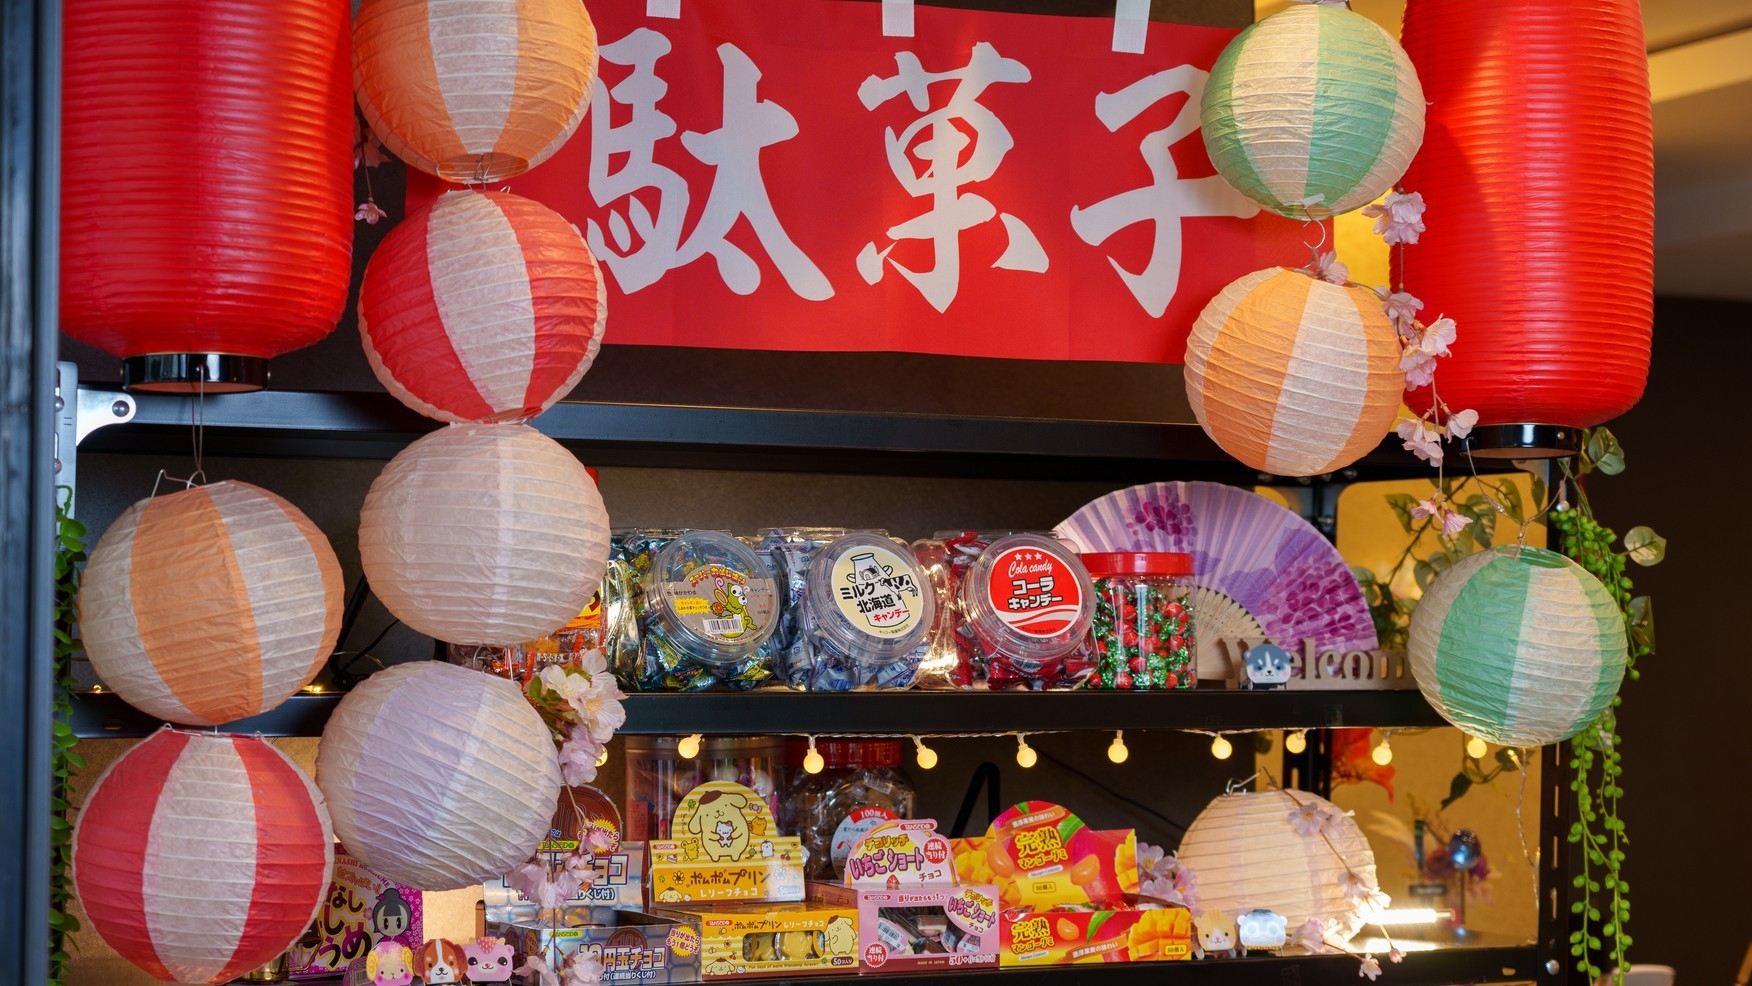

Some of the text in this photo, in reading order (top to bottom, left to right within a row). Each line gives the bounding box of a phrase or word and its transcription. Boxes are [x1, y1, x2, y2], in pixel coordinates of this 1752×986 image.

[571, 26, 1260, 318] 駄菓子
[1008, 559, 1053, 578] Cola candy
[840, 581, 876, 600] ミルク
[1011, 575, 1055, 596] コーラ
[856, 593, 896, 614] 北海道
[1008, 592, 1063, 610] キャンデー
[873, 608, 909, 622] キャンデー
[1017, 827, 1061, 856] 完熟
[1019, 850, 1068, 870] マンゴーグミ
[690, 868, 771, 886] ポムポムプリン
[919, 869, 942, 882] チョコ
[700, 887, 759, 897] レリーフチョコ
[783, 919, 825, 928] レリーフチョコ
[968, 922, 984, 934] チョコ
[1012, 917, 1050, 943] 完熟
[670, 929, 700, 944] 当りが出たら
[1011, 936, 1055, 954] マンゴーグミ
